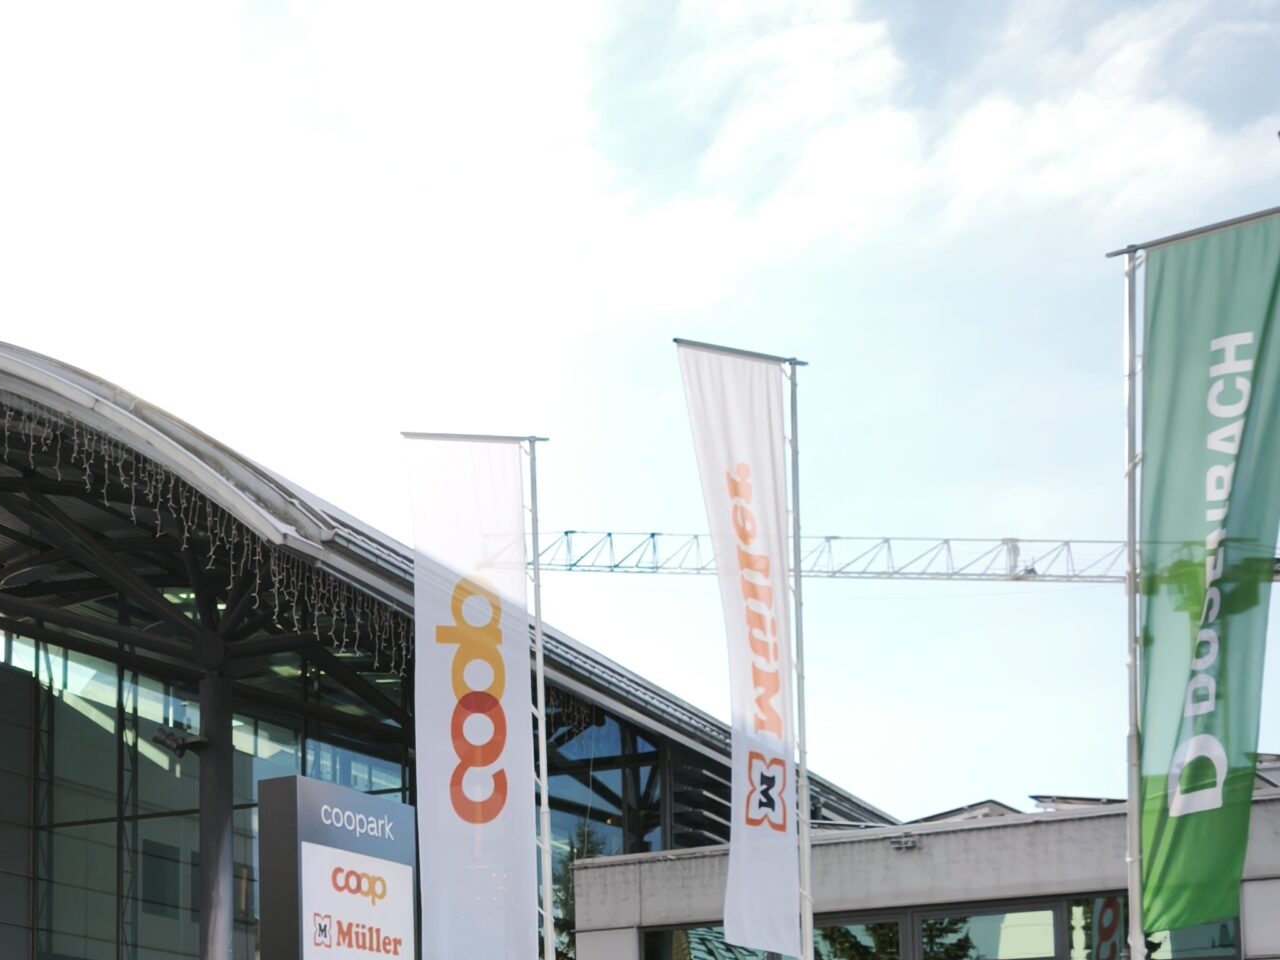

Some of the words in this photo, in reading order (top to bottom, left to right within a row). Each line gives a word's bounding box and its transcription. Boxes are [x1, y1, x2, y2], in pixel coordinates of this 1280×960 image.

[725, 461, 783, 740] Müller
[435, 573, 508, 825] coop
[321, 804, 395, 841] coopark
[331, 866, 387, 906] coop
[336, 919, 402, 956] Müller
